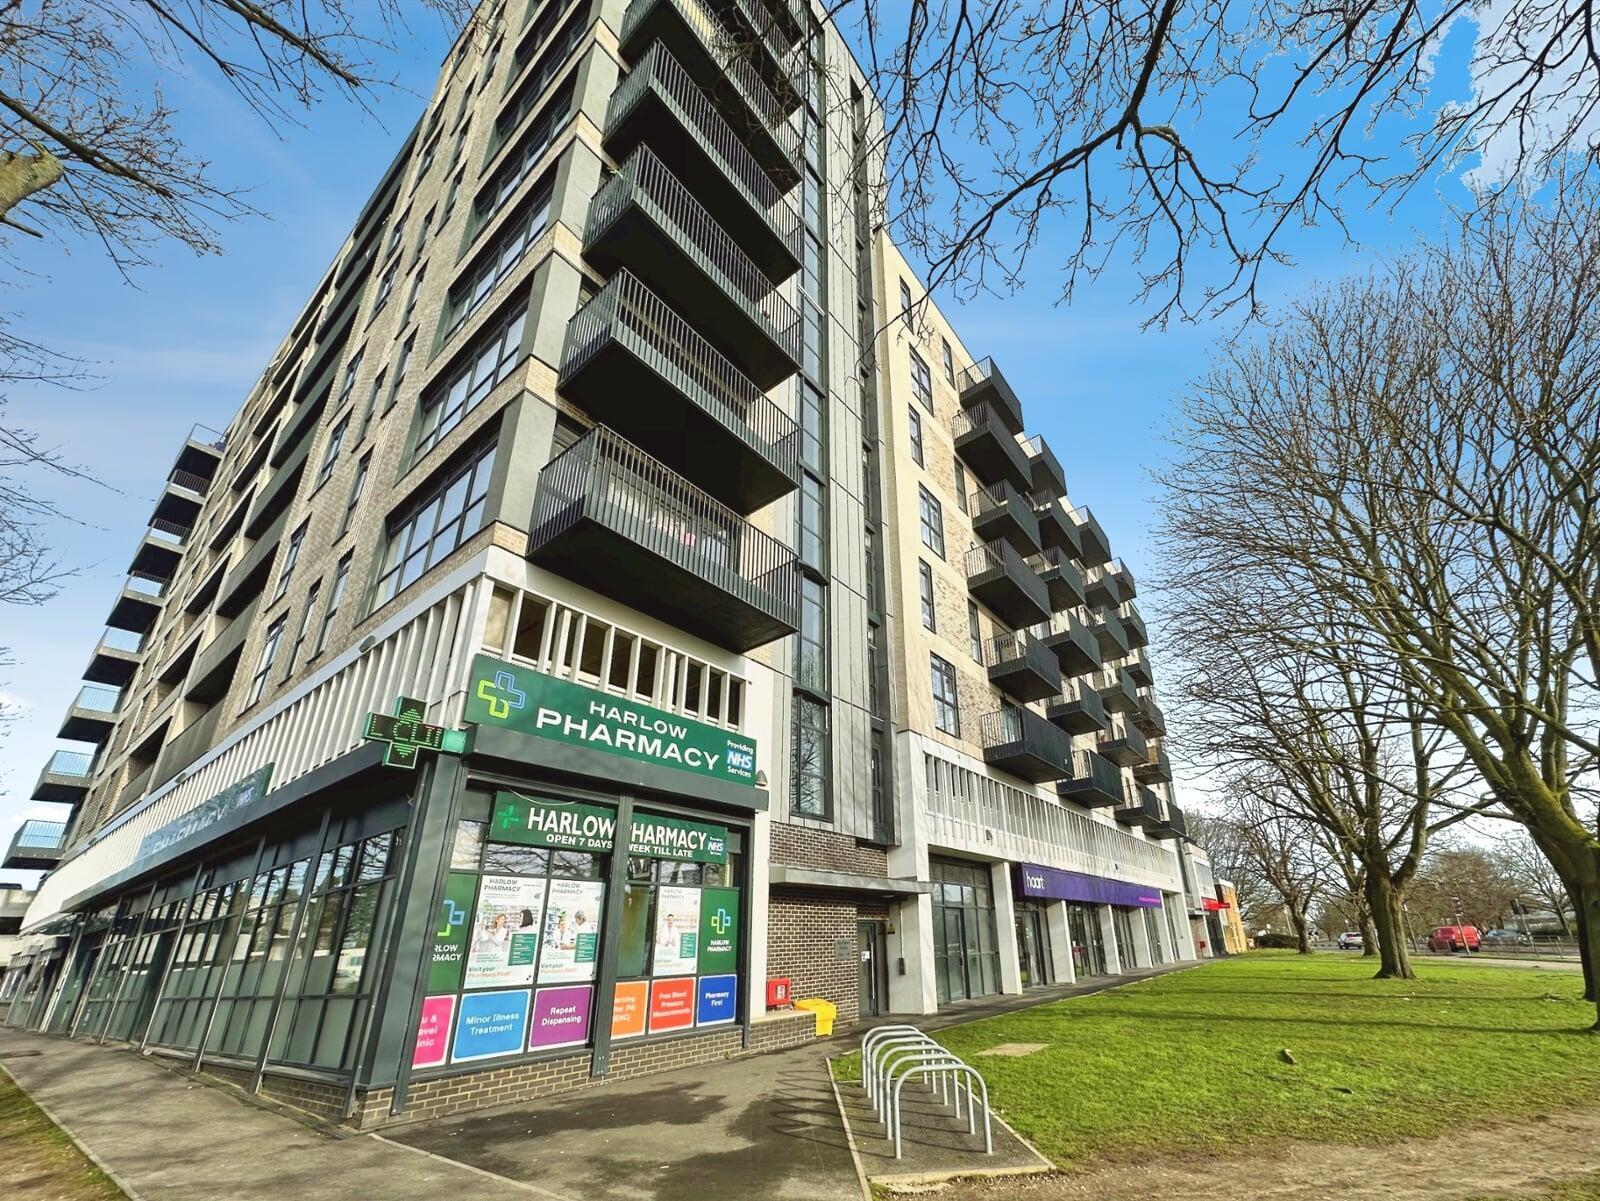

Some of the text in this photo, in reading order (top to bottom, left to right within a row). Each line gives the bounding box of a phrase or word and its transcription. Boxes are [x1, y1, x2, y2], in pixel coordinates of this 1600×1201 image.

[589, 700, 688, 740] HARLOW
[535, 707, 720, 771] PHARMACY
[727, 739, 754, 755] Providing
[727, 750, 753, 769] NHS
[727, 765, 752, 778] Services
[527, 807, 708, 851] HARLOW HARMACY
[545, 833, 576, 846] OPEN
[578, 837, 586, 847] 7
[587, 837, 613, 849] DAYS
[652, 846, 672, 856] TILL
[672, 848, 694, 858] LATE
[483, 884, 521, 892] PHARMACY
[550, 1005, 576, 1016] Repeat
[465, 1012, 520, 1025] Minor Illness
[541, 1015, 582, 1026] Dispensing
[470, 1024, 513, 1035] Treatment
